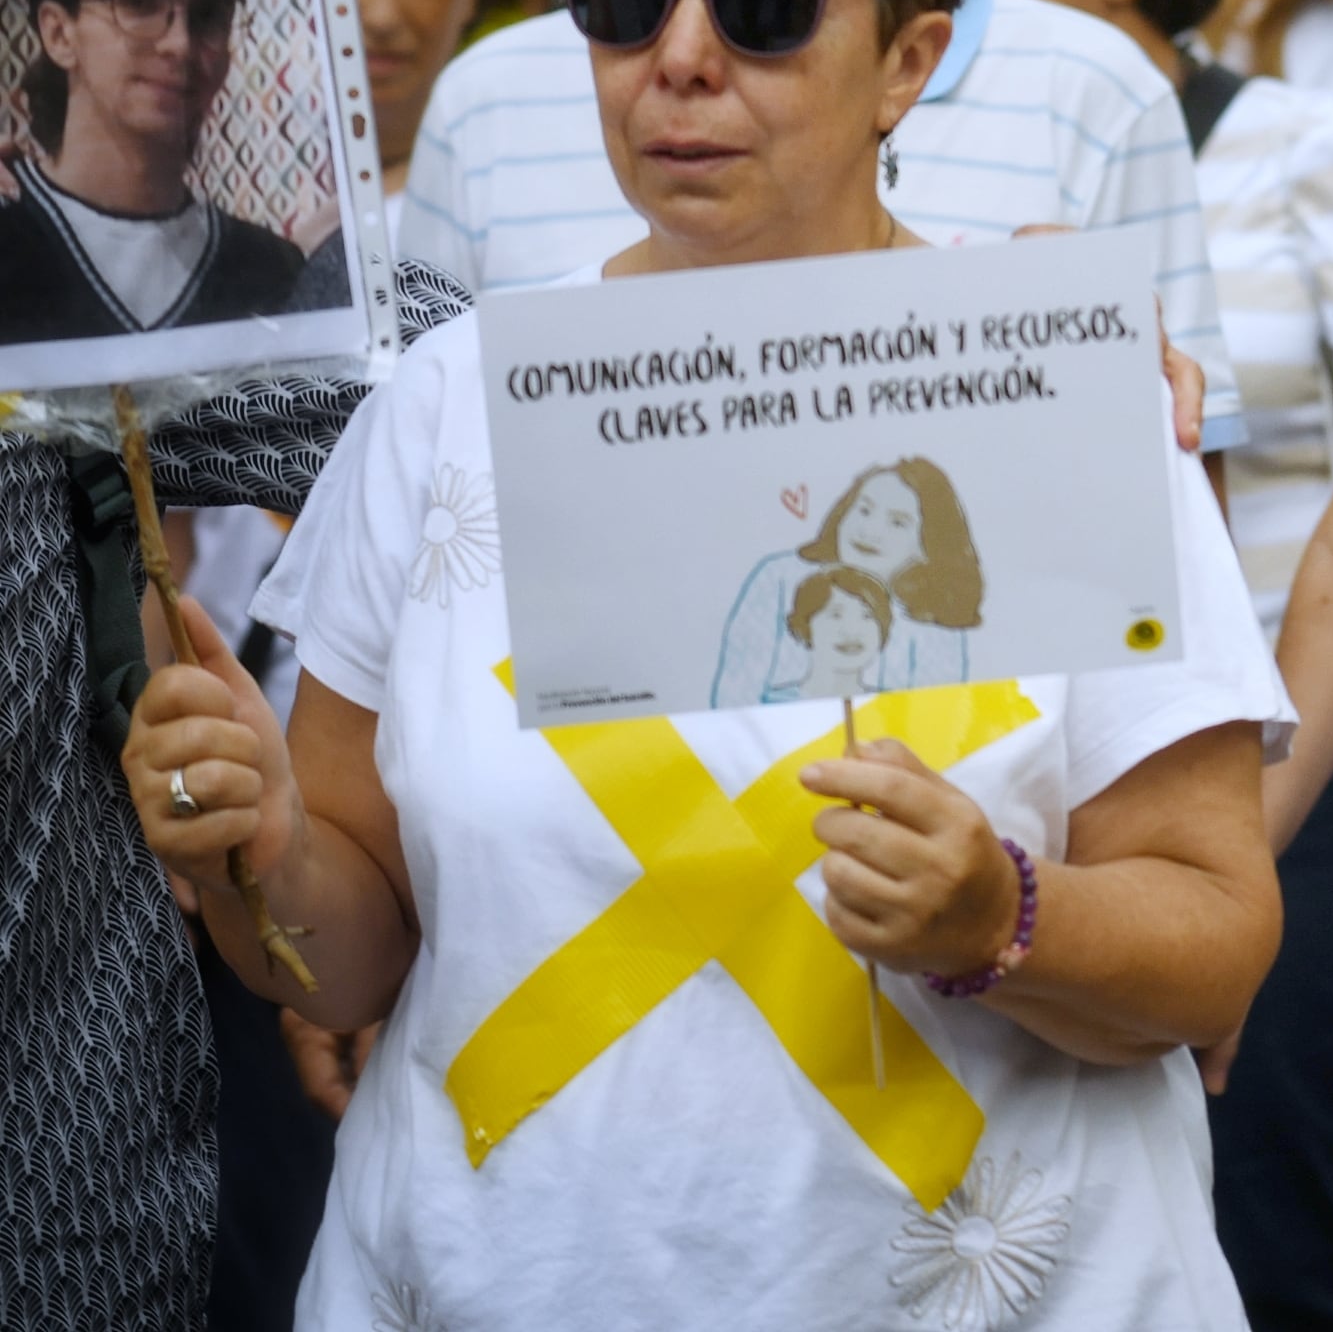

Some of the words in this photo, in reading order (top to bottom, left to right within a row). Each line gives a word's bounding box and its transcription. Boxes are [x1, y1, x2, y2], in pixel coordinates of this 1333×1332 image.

[507, 331, 747, 402] COMUNICACIÓN,
[759, 311, 938, 377] FORMACIÓN
[949, 319, 966, 355] Y
[981, 304, 1138, 351] RECURSOS,
[599, 400, 708, 445] CLAVES
[723, 390, 797, 433] PARA
[813, 385, 854, 422] LA
[868, 353, 1056, 416] PREVENCIÓN.
